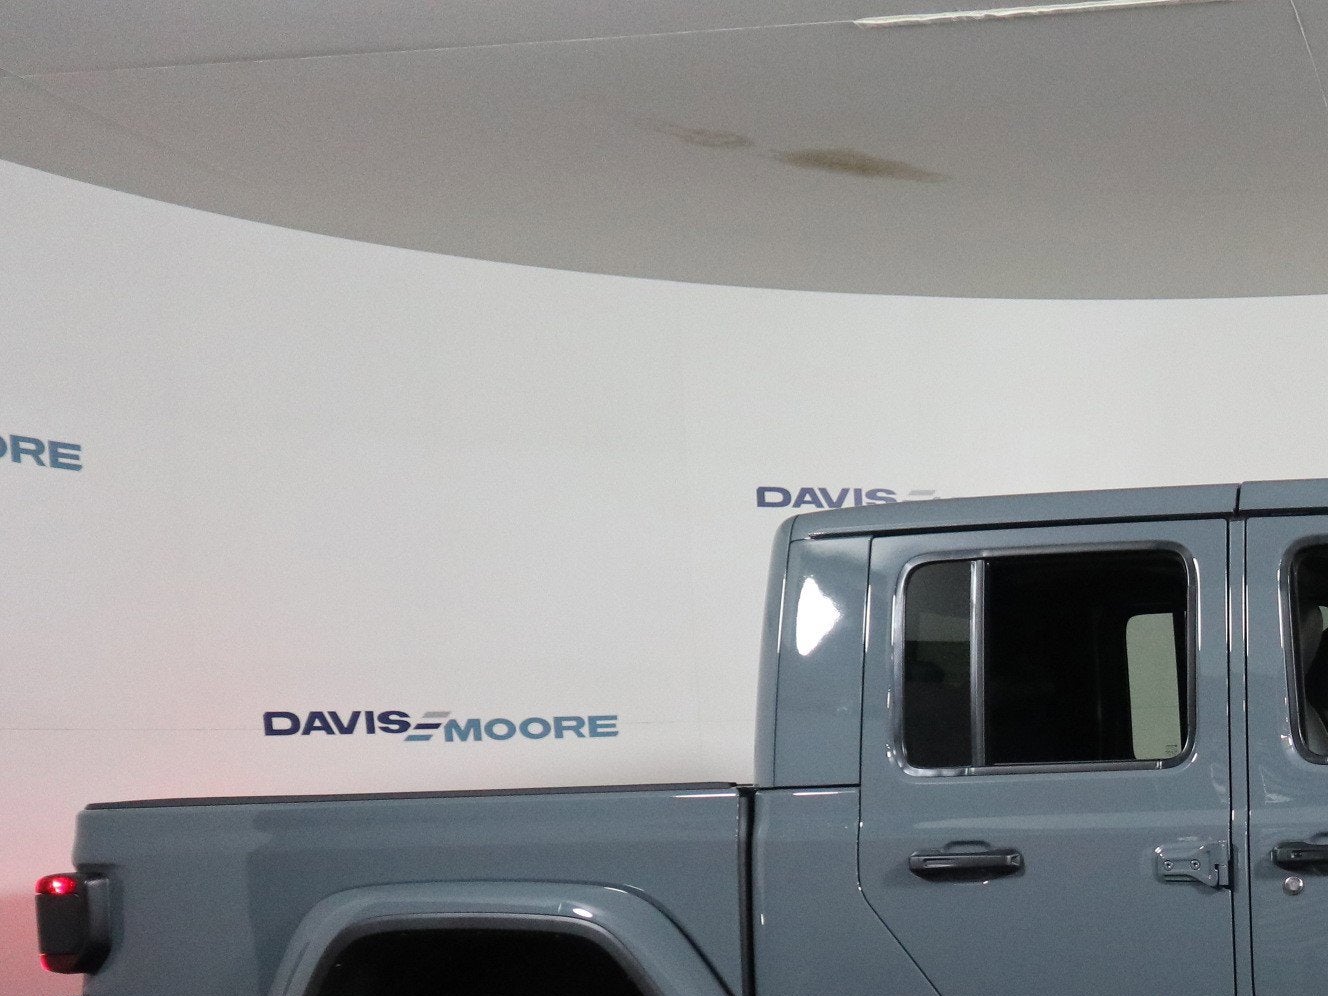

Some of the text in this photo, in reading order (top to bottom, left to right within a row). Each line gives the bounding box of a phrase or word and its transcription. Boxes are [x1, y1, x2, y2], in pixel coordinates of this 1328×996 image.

[0, 434, 83, 471] RE
[756, 486, 897, 508] DAVIS
[263, 710, 619, 742] DAVIS MOORE
